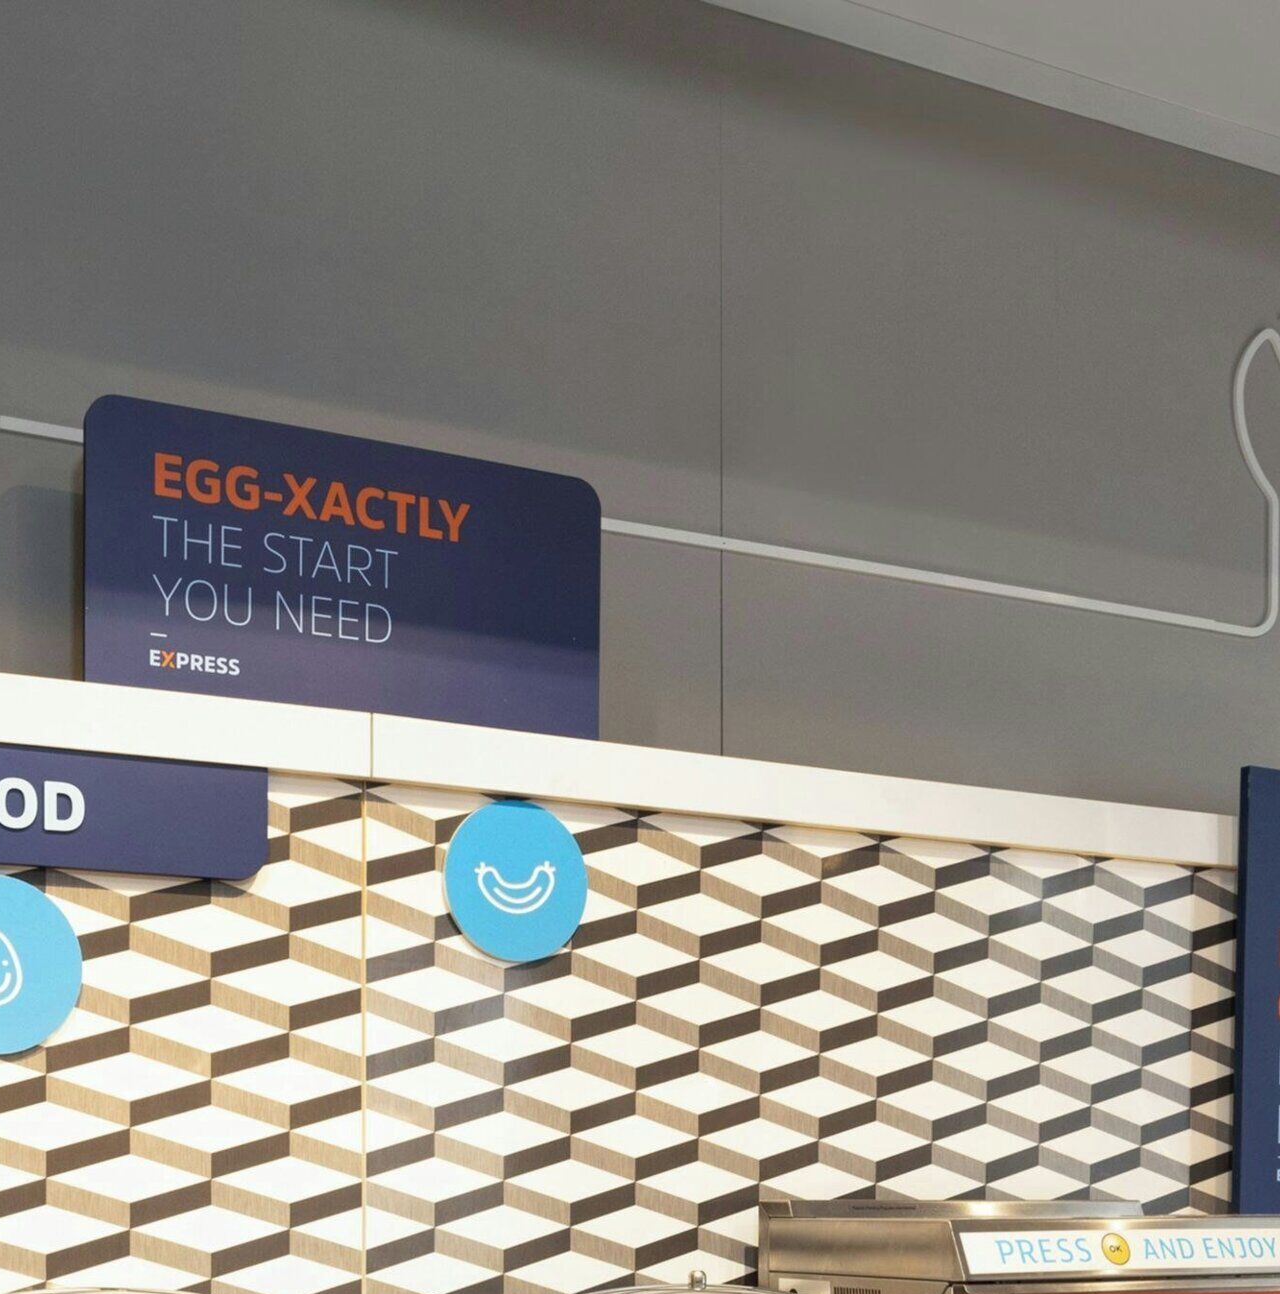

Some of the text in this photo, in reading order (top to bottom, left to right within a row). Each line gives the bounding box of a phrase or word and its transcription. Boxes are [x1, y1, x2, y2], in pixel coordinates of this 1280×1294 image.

[154, 452, 471, 542] EGG-XACTLY
[152, 515, 398, 589] THE START
[152, 574, 392, 644] YOU NEED
[150, 649, 240, 676] EXPRESS
[995, 1238, 1092, 1264] PRESS
[1110, 1245, 1122, 1253] OK
[1144, 1237, 1194, 1259] AND
[1202, 1237, 1276, 1259] ENJOY
